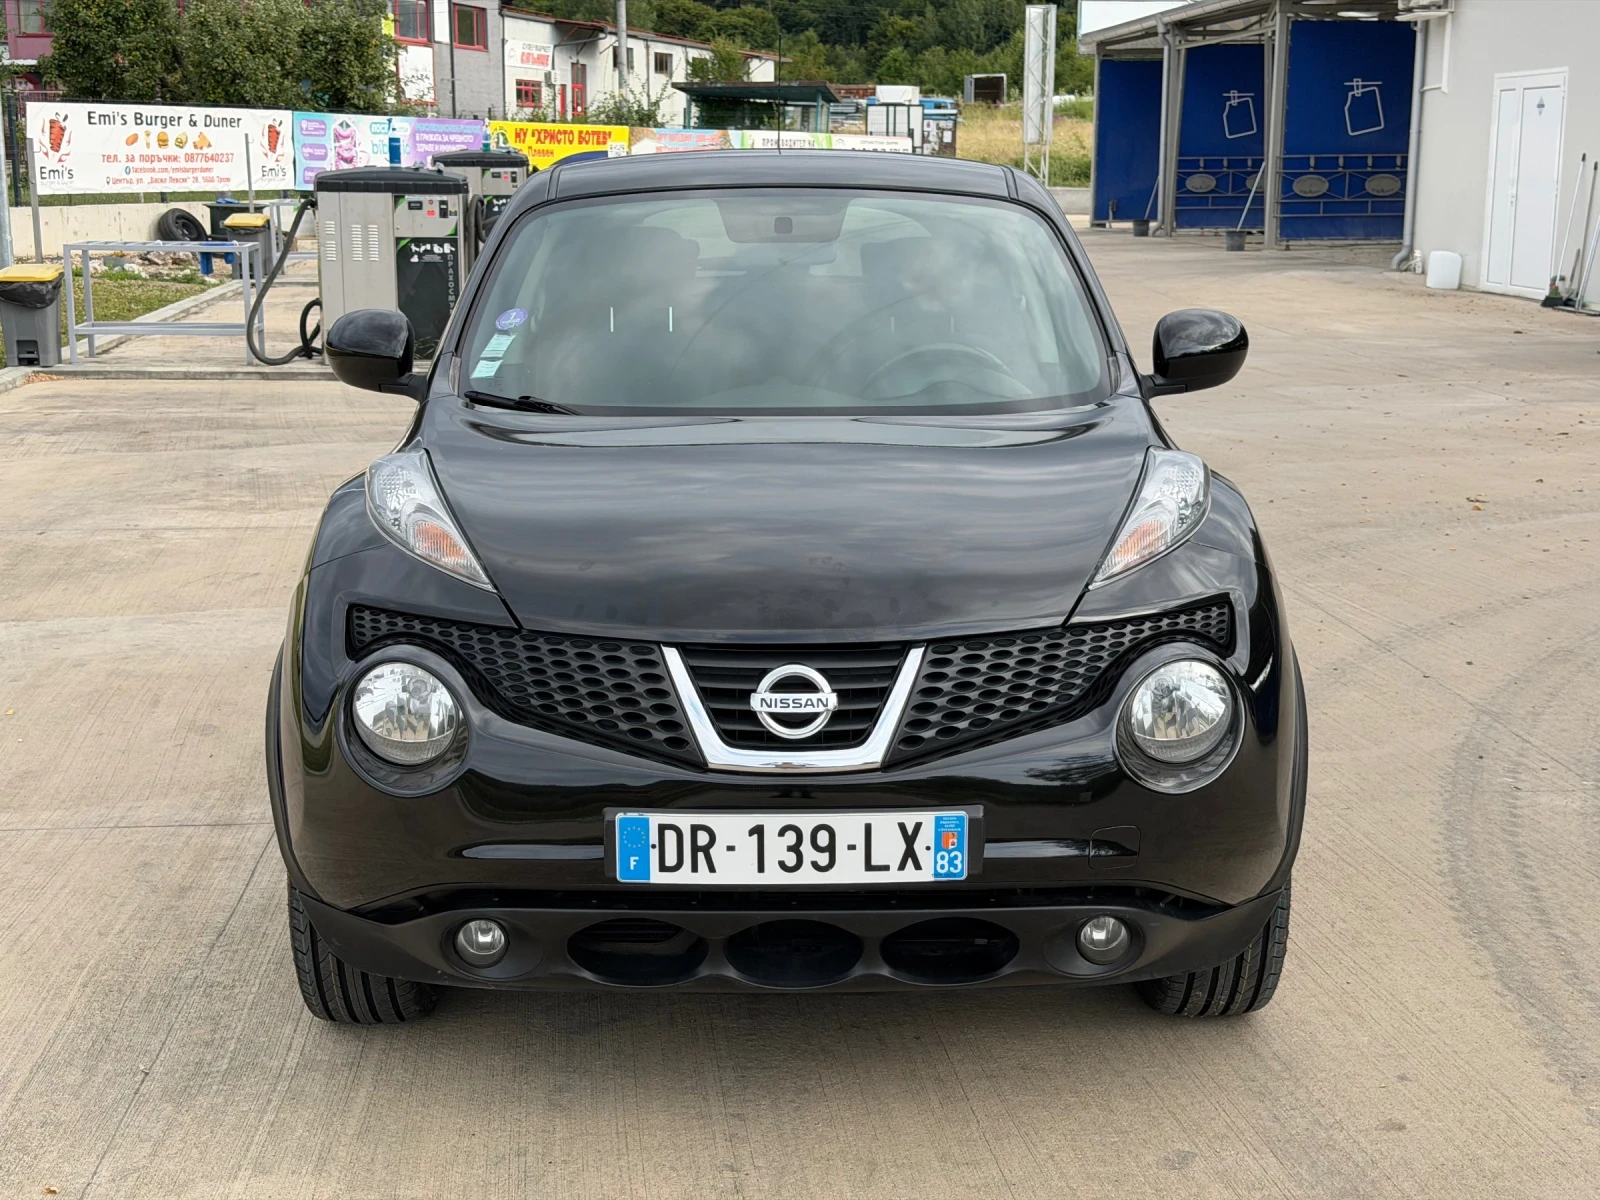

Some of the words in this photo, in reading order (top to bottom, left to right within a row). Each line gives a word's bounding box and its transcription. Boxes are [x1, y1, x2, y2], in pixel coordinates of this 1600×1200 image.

[87, 110, 128, 126] Emi's
[134, 112, 183, 129] Burger
[188, 114, 198, 127] &
[204, 114, 242, 128] Duner
[514, 128, 528, 144] НУ
[101, 154, 122, 163] тел.
[125, 155, 135, 163] за
[139, 154, 181, 164] поръчки:
[184, 152, 235, 163] 0877640237
[40, 165, 74, 180] Emi's
[261, 164, 287, 178] Emi's
[760, 697, 829, 709] NISSAN
[657, 821, 924, 874] DR-139-LX
[629, 856, 640, 871] F
[936, 850, 963, 874] 83
